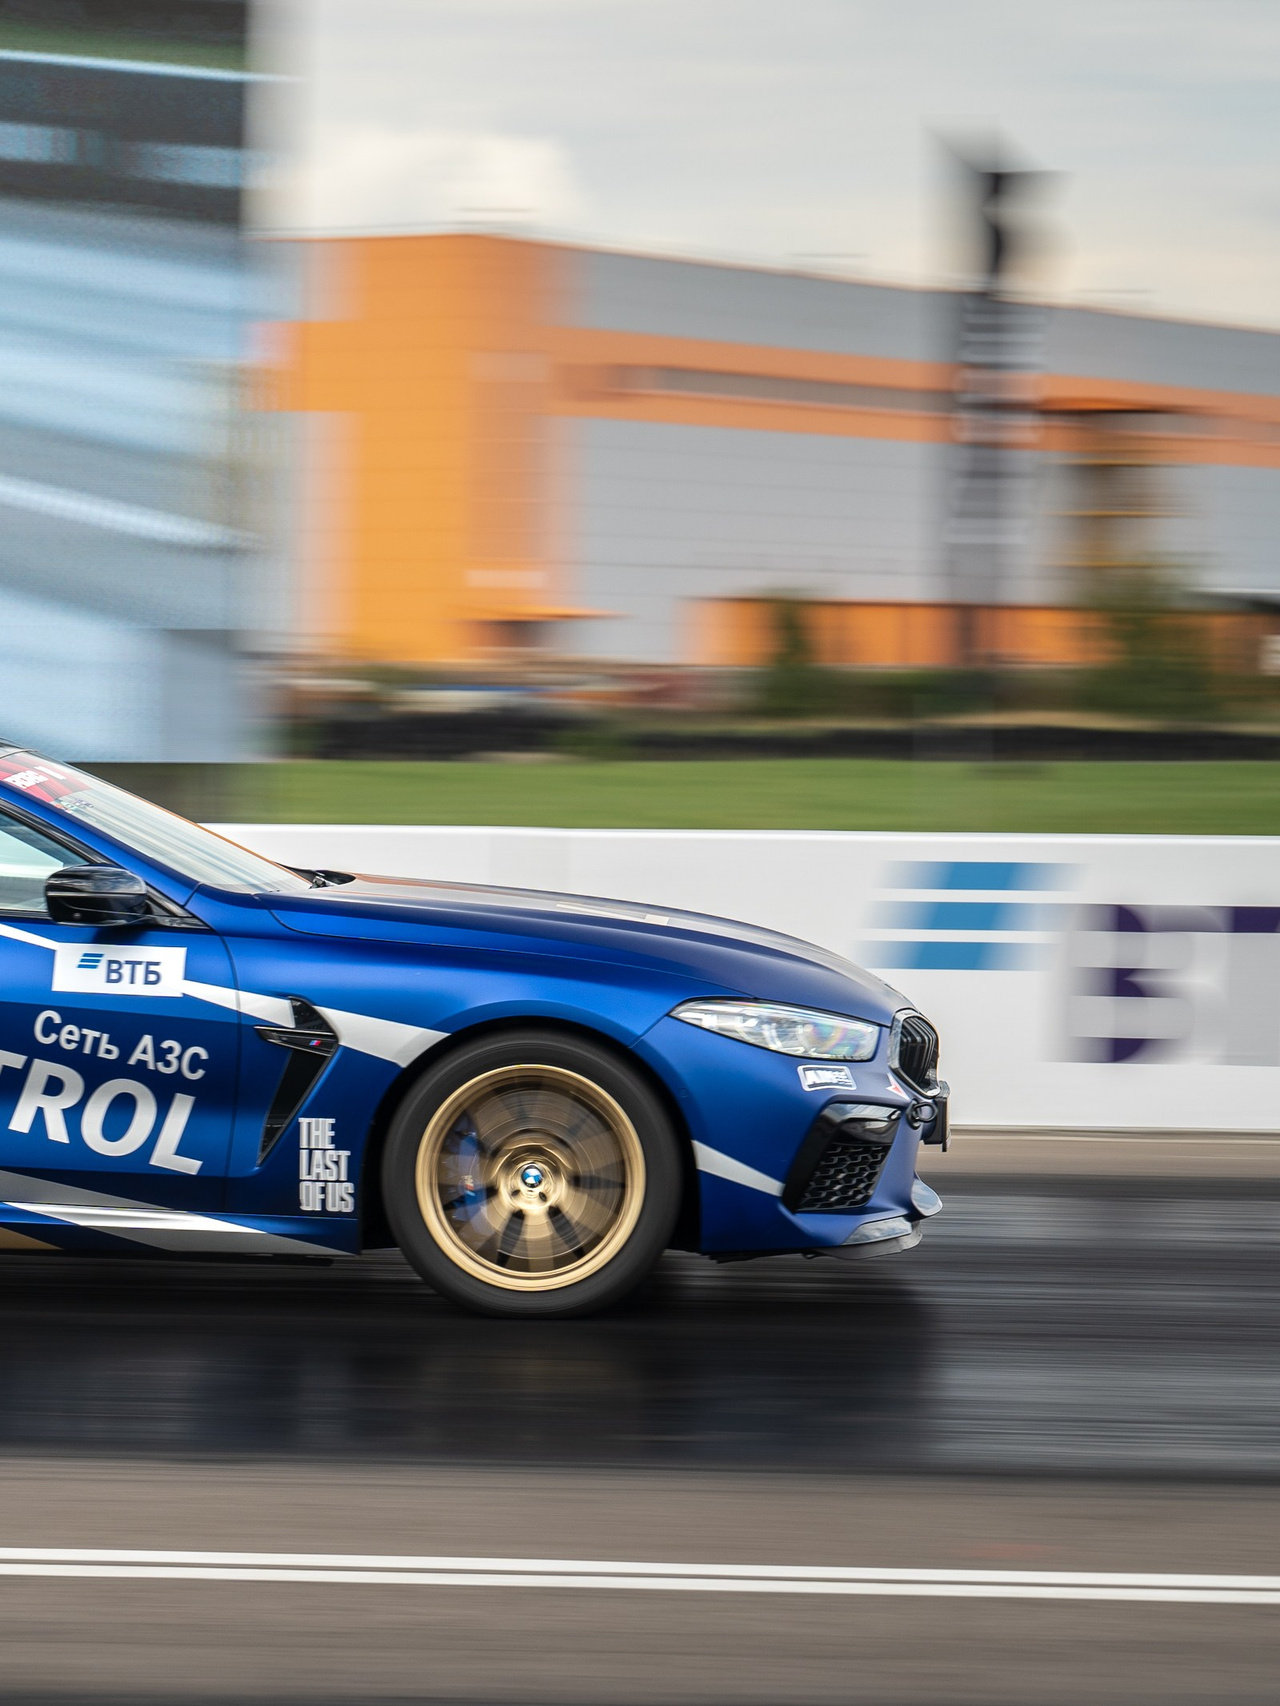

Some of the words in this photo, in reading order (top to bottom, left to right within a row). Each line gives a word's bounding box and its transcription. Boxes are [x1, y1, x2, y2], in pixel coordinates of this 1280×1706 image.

[105, 959, 162, 986] ВТБ
[33, 1009, 121, 1060] Сеть
[127, 1034, 210, 1081] АЗС
[298, 1117, 336, 1149] THE
[299, 1149, 351, 1181] LAST
[299, 1181, 326, 1211] OF
[325, 1182, 355, 1213] US
